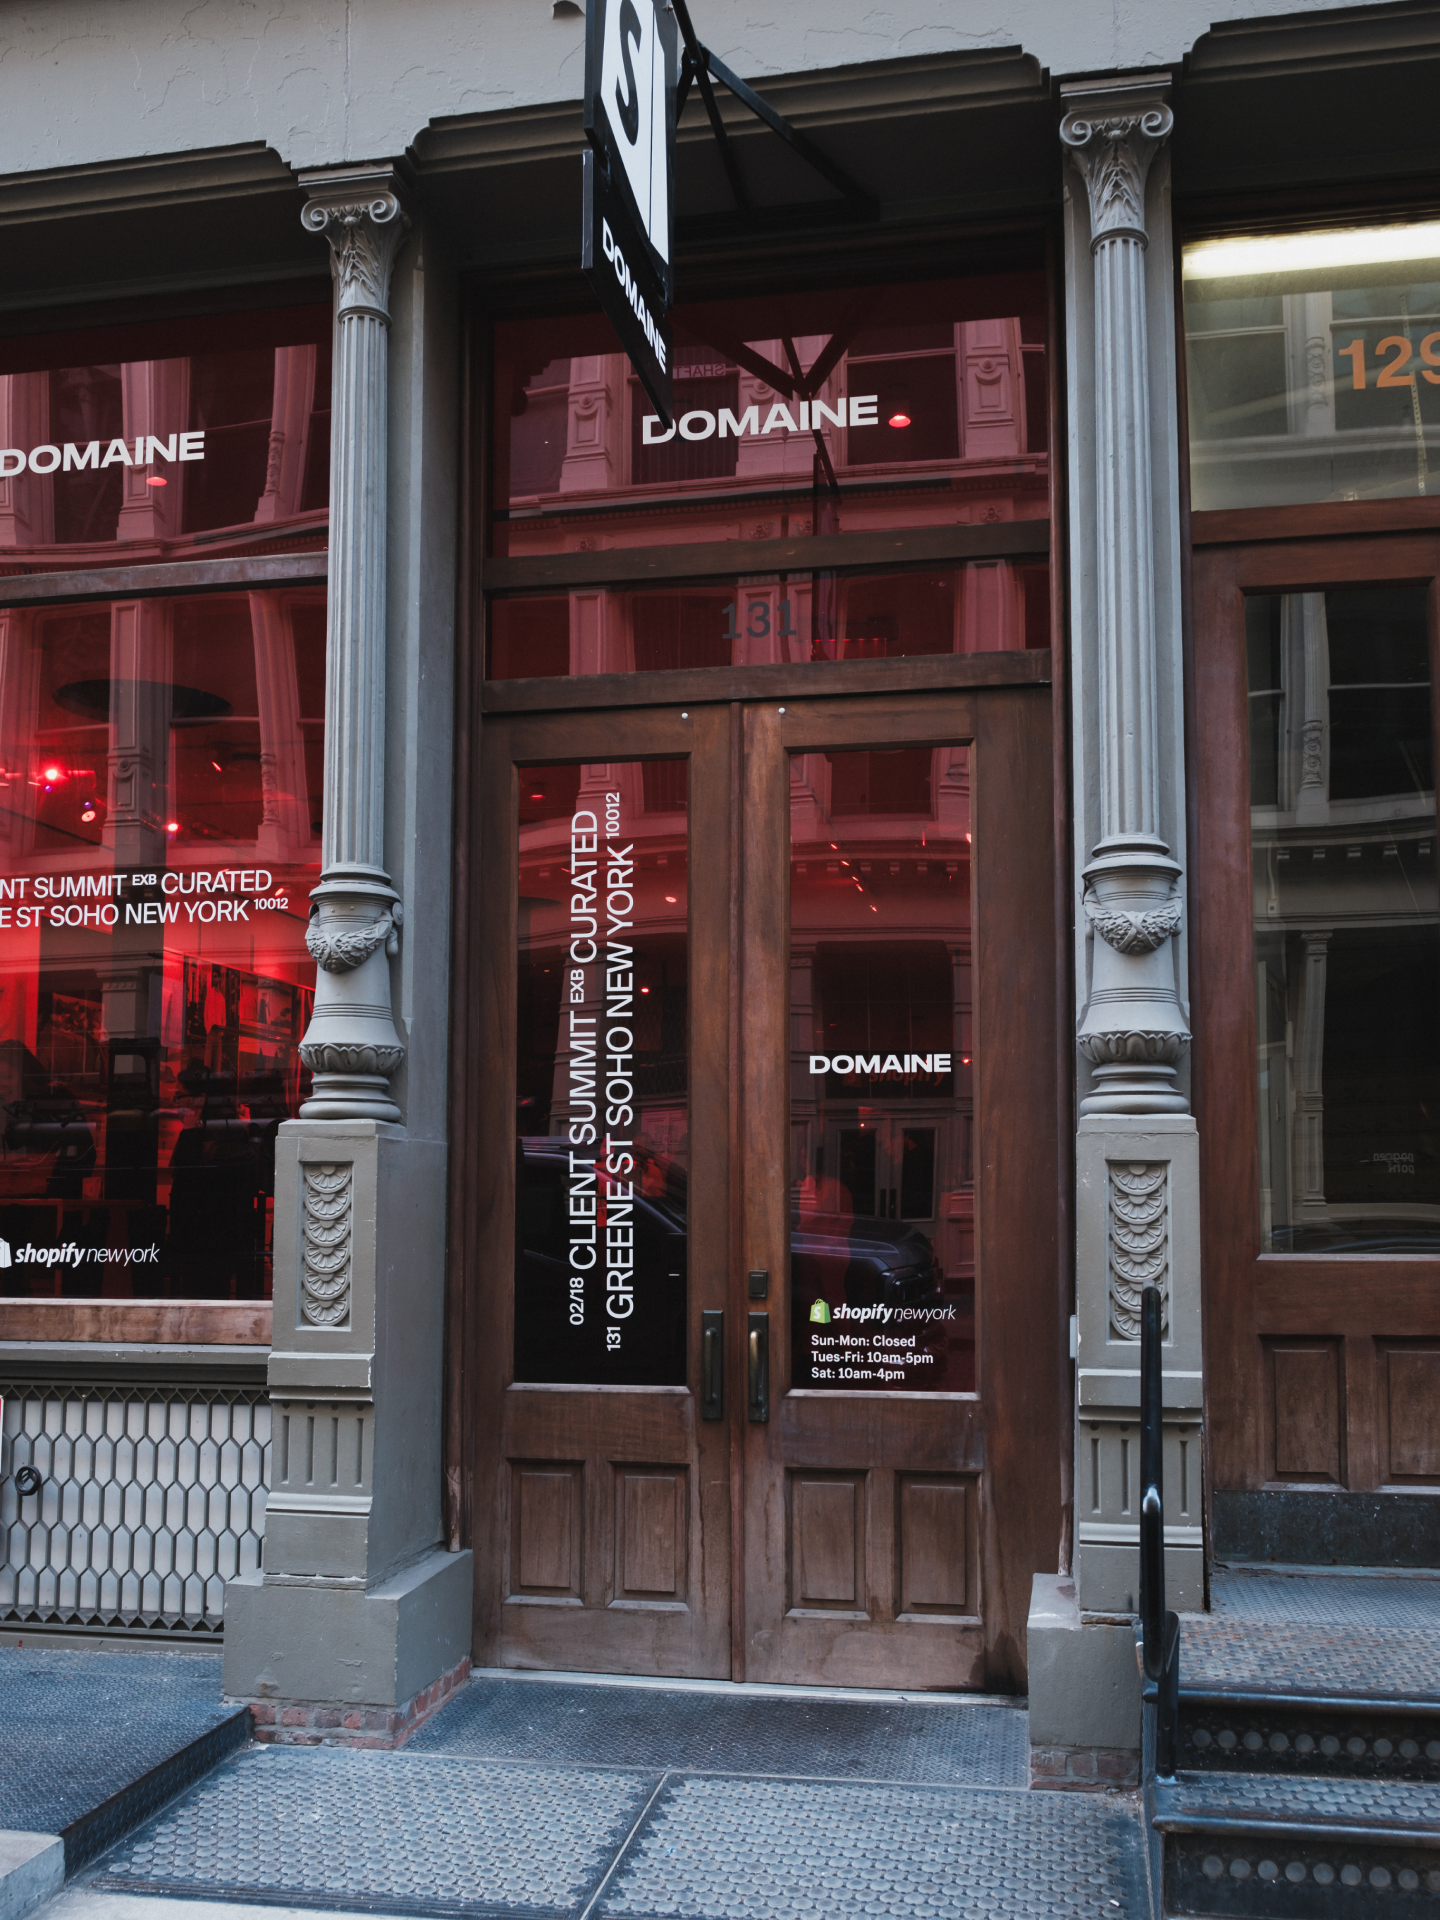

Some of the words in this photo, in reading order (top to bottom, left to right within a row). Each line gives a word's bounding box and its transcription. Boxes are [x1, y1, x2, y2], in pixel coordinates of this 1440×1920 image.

[602, 217, 666, 374] DOMAINE
[642, 395, 878, 445] DOMAINE
[0, 431, 205, 477] DOMAINE
[721, 599, 797, 639] 131
[605, 791, 620, 840] 10012
[33, 874, 127, 898] SUMMIT
[132, 873, 157, 886] EXB
[161, 870, 272, 894] CURATED
[570, 810, 598, 963] CURATED
[606, 843, 634, 936] YORK
[16, 905, 45, 928] ST
[49, 903, 119, 927] SOHO
[125, 902, 180, 924] NEW
[183, 899, 250, 923] YORK
[253, 897, 289, 910] 10012
[569, 968, 585, 1004] EXB
[606, 942, 634, 1017] NEW
[569, 1010, 597, 1145] SUMMIT
[606, 1026, 634, 1127] SOHO
[809, 1053, 952, 1075] DOMAINE
[606, 1132, 634, 1174] ST
[569, 1150, 597, 1270] CLIENT
[15, 1242, 86, 1269] shopify
[606, 1181, 634, 1319] GREENE
[569, 1276, 585, 1326] 02/18
[832, 1303, 893, 1324] shopify
[606, 1326, 621, 1352] 131
[811, 1334, 870, 1346] Sun-Mon:
[872, 1335, 916, 1347] Closed
[811, 1350, 864, 1363] Tues-Fri:
[866, 1351, 934, 1366] 10am-5pm
[811, 1367, 836, 1379] Sat:
[838, 1368, 905, 1382] 10am-4pm
